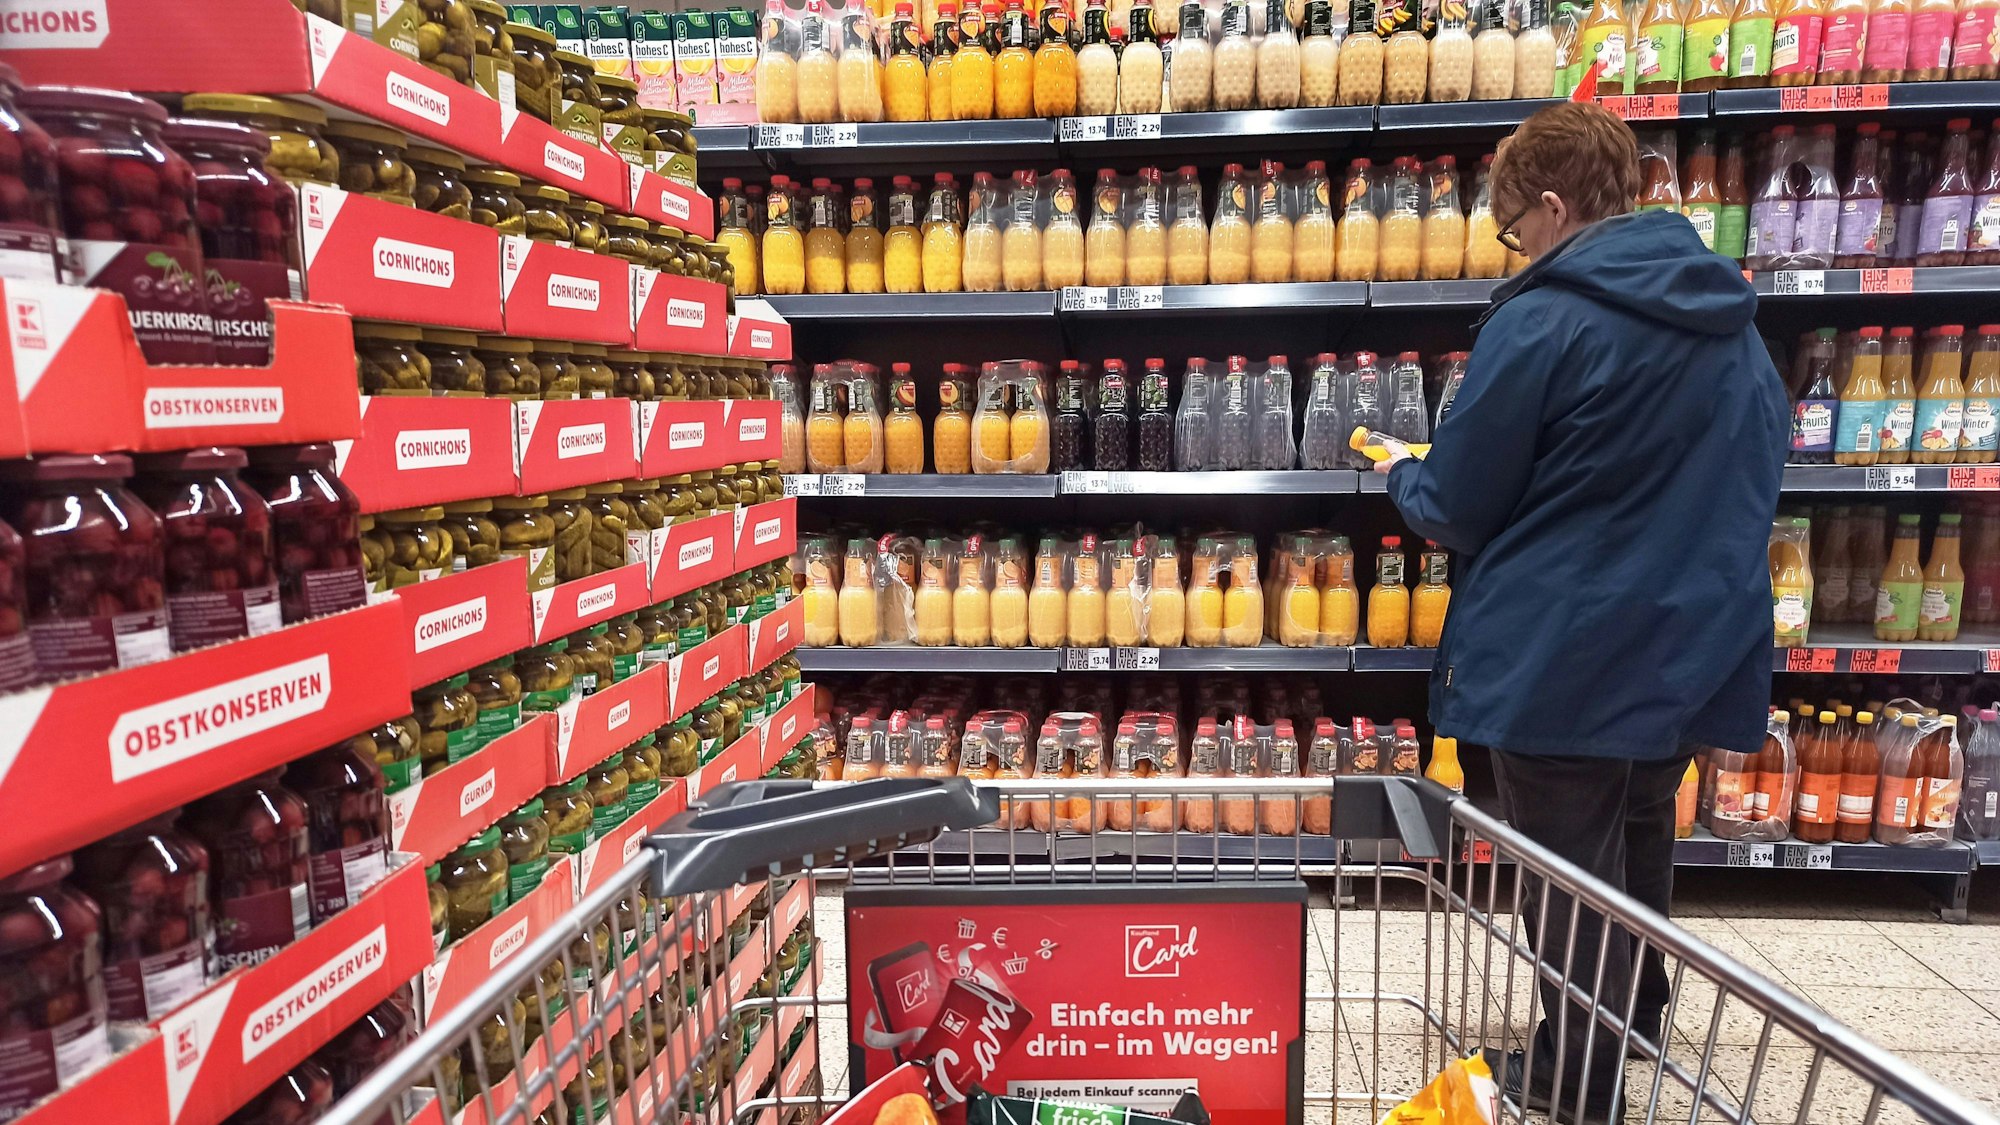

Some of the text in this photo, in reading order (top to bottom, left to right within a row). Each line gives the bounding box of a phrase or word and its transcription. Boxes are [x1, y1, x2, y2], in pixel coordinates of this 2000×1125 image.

[590, 43, 617, 55] hohes
[618, 43, 624, 54] C
[635, 44, 669, 56] hohes C
[678, 41, 710, 55] hohes C
[720, 41, 753, 54] hohes C
[1784, 89, 1806, 99] EIN-
[1839, 87, 1861, 97] EIN-
[391, 82, 446, 117] CORNICHONS
[1631, 97, 1653, 106] EIN-
[1782, 99, 1807, 110] WEG
[1837, 98, 1862, 108] WEG
[1629, 107, 1654, 117] WEG
[1063, 119, 1082, 129] EIN-
[1118, 117, 1136, 127] EIN-
[761, 126, 780, 136] EIN-
[814, 126, 833, 135] EIN-
[1088, 126, 1106, 134] 13.74
[1116, 128, 1138, 137] WEG
[1142, 124, 1160, 132] 2.29
[786, 134, 803, 143] 13.74
[1062, 130, 1083, 140] WEG
[760, 137, 781, 147] WEG
[814, 136, 834, 145] WEG
[547, 147, 582, 173] CORNICHONS
[663, 197, 688, 214] CORNICHONS
[379, 250, 450, 277] CORNICHONS
[1777, 273, 1797, 282] EIN-
[1775, 283, 1799, 294] WEG
[1804, 279, 1823, 289] 10.74
[1863, 281, 1887, 291] WEG
[551, 283, 596, 302] CORNICHONS
[1066, 289, 1084, 298] EIN-
[1120, 288, 1138, 298] EIN-
[1064, 300, 1084, 309] WEG
[1119, 299, 1139, 308] WEG
[670, 306, 703, 321] CORNICHONS
[151, 398, 278, 416] OBSTKONSERVEN
[1963, 417, 1990, 429] Winter
[741, 425, 765, 434] CORNICHONS
[561, 431, 603, 449] CORNICHONS
[671, 430, 703, 442] CORNICHONS
[401, 440, 467, 458] CORNICHONS
[1869, 469, 1888, 478] EIN-
[1953, 468, 1973, 478] EIN-
[826, 476, 842, 485] EIN-
[1867, 479, 1890, 489] WEG
[1895, 475, 1914, 484] 9.54
[1951, 478, 1974, 487] WEG
[824, 486, 843, 494] WEG
[1066, 483, 1086, 492] WEG
[756, 524, 780, 538] CORNICHONS
[681, 544, 711, 562] CORNICHONS
[580, 590, 613, 610] CORNICHONS
[420, 608, 482, 640] CORNICHONS
[1070, 650, 1087, 659] EIN-
[1120, 648, 1136, 658] EIN-
[1791, 650, 1811, 660] EIN-
[1855, 650, 1875, 660] EIN-
[1068, 660, 1088, 669] WEG
[1118, 660, 1138, 668] WEG
[1789, 660, 1812, 670] WEG
[1853, 661, 1875, 671] WEG
[125, 672, 322, 757] OBSTKONSERVEN
[610, 707, 628, 723] GURKEN
[465, 777, 493, 805] GURKEN
[1730, 845, 1749, 855] EIN-
[1788, 847, 1806, 857] EIN-
[1729, 856, 1750, 866] WEG
[1754, 853, 1773, 862] 5.94
[1785, 858, 1807, 867] WEG
[1812, 855, 1831, 863] 0.99
[493, 926, 525, 958] GURKEN
[1133, 926, 1198, 971] Card
[251, 941, 381, 1042] OBSTKONSERVEN
[904, 969, 931, 1007] Card
[1051, 1003, 1254, 1027] Einfach mehr
[935, 978, 1015, 1102] Card
[1026, 1033, 1087, 1057] drin
[1117, 1034, 1156, 1056] im
[1163, 1031, 1278, 1060] Wagen!
[1017, 1087, 1037, 1097] Bei
[1041, 1086, 1081, 1098] jedem
[1085, 1086, 1133, 1097] Einkauf
[1053, 1108, 1113, 1125] frisch
